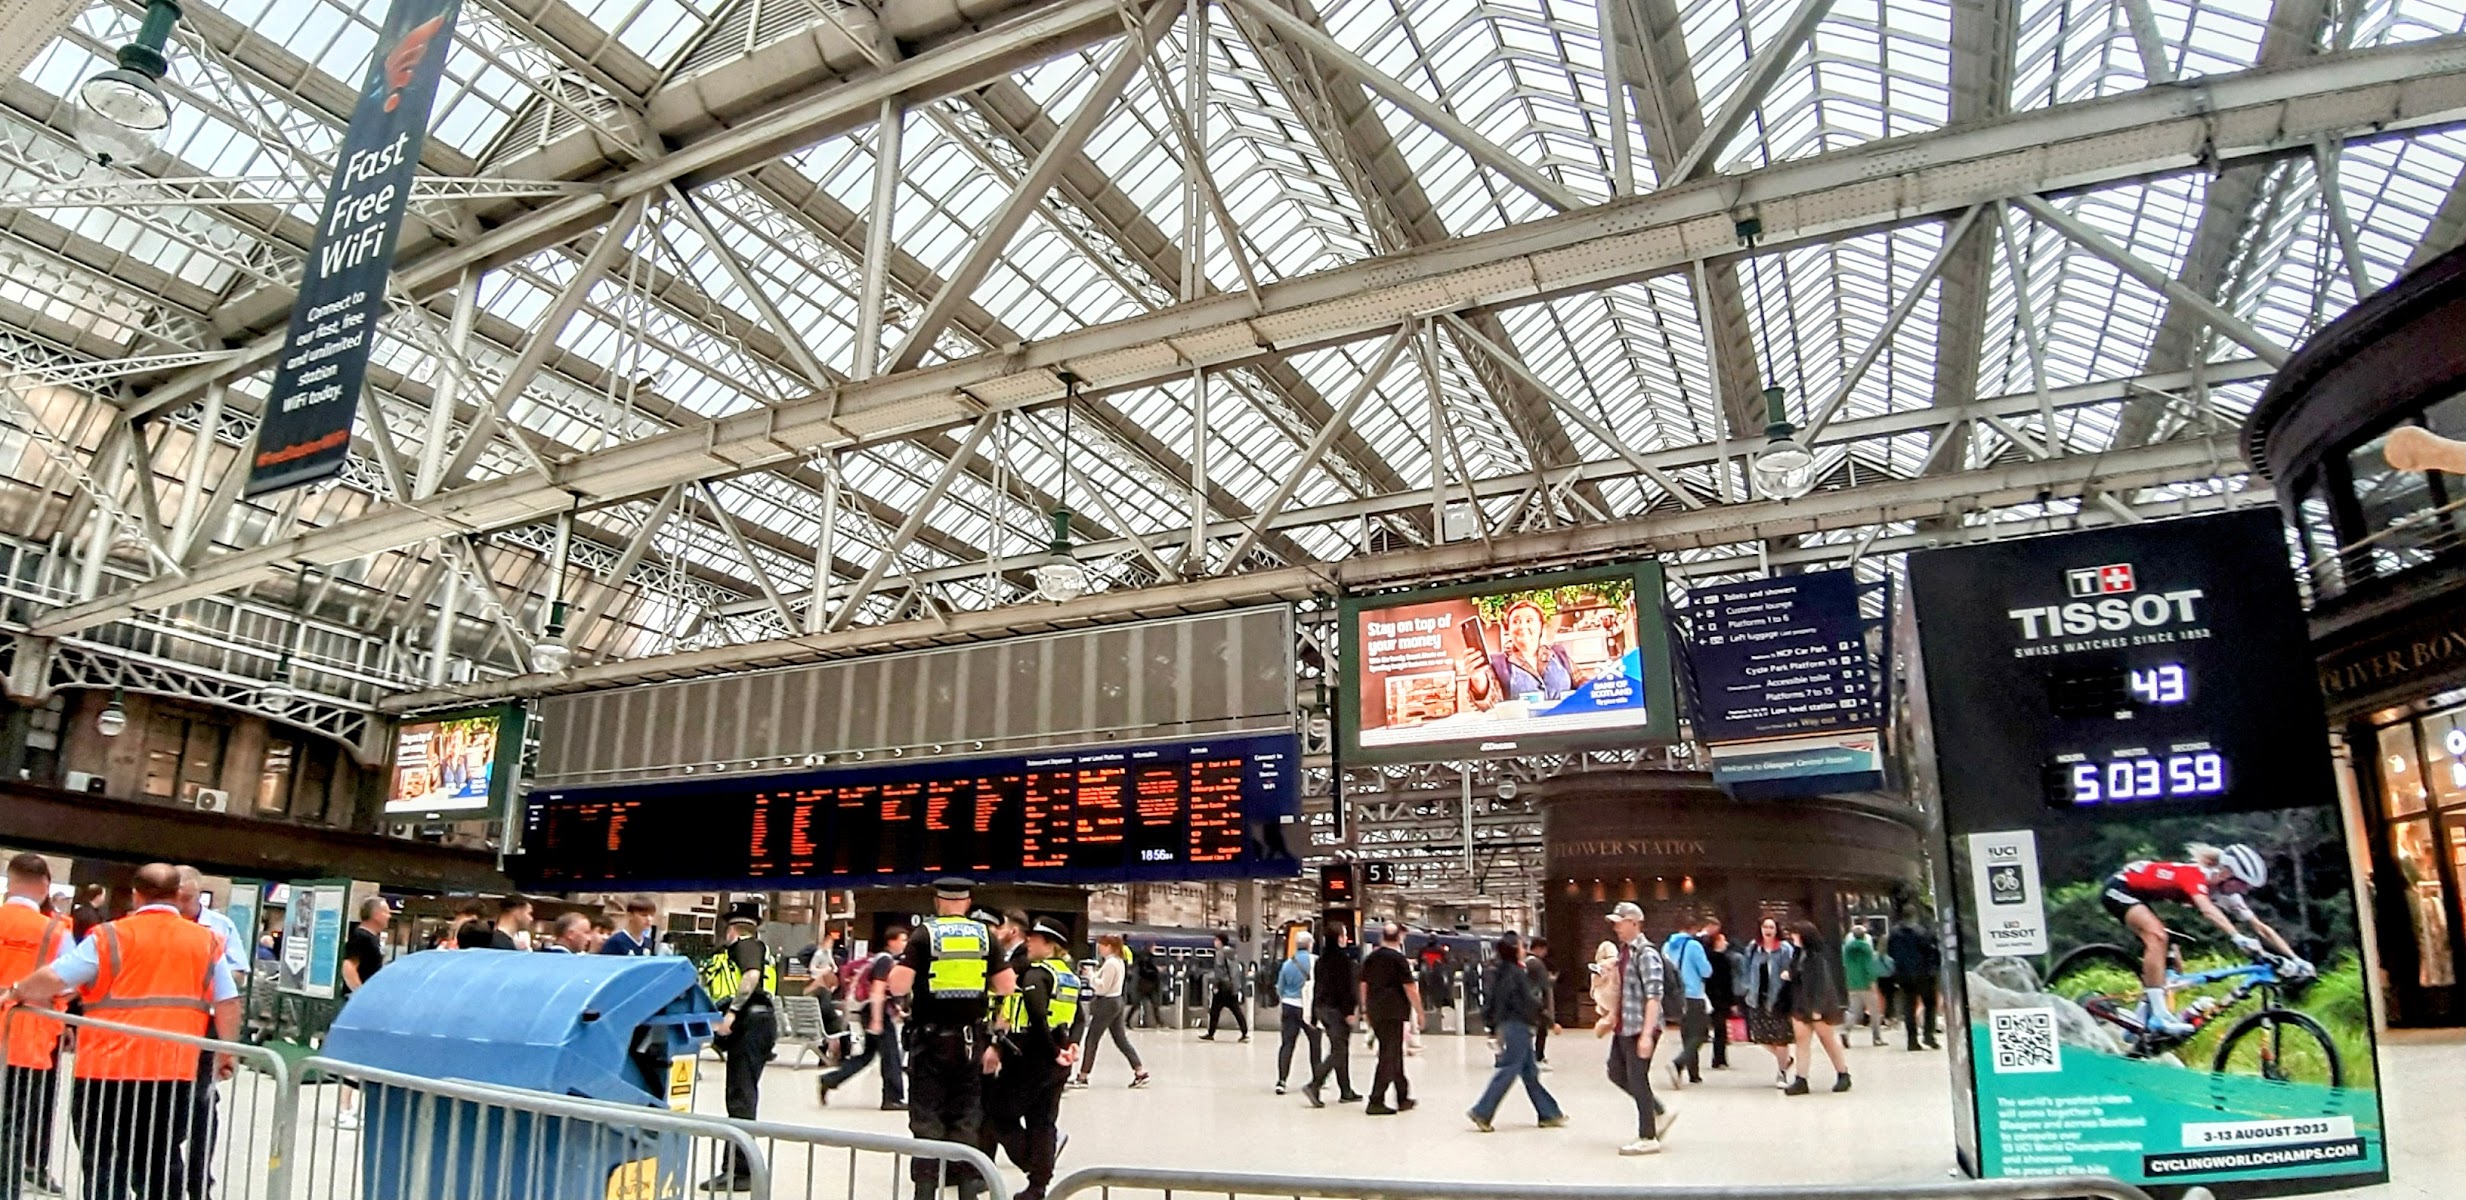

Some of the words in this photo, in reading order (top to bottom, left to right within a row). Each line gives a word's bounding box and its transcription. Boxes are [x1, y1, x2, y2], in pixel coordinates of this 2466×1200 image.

[341, 131, 409, 191] Fast
[327, 184, 395, 237] Free
[320, 221, 387, 279] WiFi
[307, 296, 352, 322] Connect
[352, 291, 366, 305] to
[296, 330, 315, 346] our
[341, 312, 365, 329] free
[286, 350, 309, 370] and
[309, 330, 363, 362] unlimited
[297, 364, 338, 387] station
[1723, 593, 1748, 602] Toilets
[1749, 590, 1763, 598] and
[1764, 587, 1797, 596] showers
[1725, 605, 1763, 615] Customer
[1765, 601, 1793, 610] lounge
[2008, 589, 2204, 640] TISSOT
[1368, 622, 1396, 638] Stay
[1397, 620, 1414, 633] on
[1414, 618, 1436, 634] top
[1437, 612, 1452, 629] of
[1728, 618, 1766, 629] Platforms
[1729, 633, 1746, 643] Left
[1746, 631, 1779, 641] luggage
[2014, 644, 2059, 658] SWISS
[2063, 637, 2128, 653] WATCHES
[2133, 631, 2175, 646] SINCE
[2180, 628, 2211, 640] 1853
[1368, 639, 1397, 657] your
[1398, 633, 1442, 650] money
[1776, 648, 1793, 658] NCP
[1794, 647, 1809, 656] Car
[1810, 645, 1828, 654] Park
[1745, 667, 1769, 676] Cycle
[1770, 664, 1789, 672] Park
[1789, 660, 1827, 670] Platform
[1766, 677, 1808, 687] Accessible
[2131, 664, 2185, 702] 43
[1591, 687, 1633, 698] SCOTLAND
[1765, 691, 1805, 700] Platforms
[1823, 687, 1834, 695] 15
[1770, 707, 1788, 715] Low
[1788, 705, 1808, 713] level
[1808, 703, 1837, 711] station
[1721, 765, 1753, 773] Welcome
[1763, 761, 1795, 770] Glasgow
[1796, 759, 1824, 767] Central
[2073, 764, 2100, 802] 5
[2108, 759, 2162, 798] 03
[2168, 753, 2222, 793] 59
[1627, 840, 1705, 856] STATION
[1369, 865, 1380, 881] 5
[1990, 929, 2036, 939] TISSOT
[1997, 1097, 2016, 1107] The
[2055, 1096, 2099, 1109] greatest
[2099, 1095, 2132, 1105] riders
[1998, 1108, 2016, 1118] will
[2017, 1109, 2046, 1118] come
[2046, 1107, 2092, 1120] together
[2000, 1120, 2042, 1131] Glasgow
[2044, 1120, 2062, 1129] and
[2063, 1120, 2098, 1129] across
[2098, 1117, 2147, 1128] Scotland
[2014, 1132, 2058, 1143] compete
[2059, 1132, 2082, 1141] over
[2204, 1131, 2232, 1142] 3-13
[2235, 1126, 2292, 1140] AUGUST
[2014, 1142, 2034, 1152] UCI
[2034, 1142, 2064, 1152] World
[2064, 1141, 2143, 1153] Championships
[2002, 1155, 2022, 1164] and
[2023, 1154, 2073, 1164] showcase
[2151, 1143, 2359, 1173] CYCLINGWORLDCHAMPS.COM
[2004, 1166, 2021, 1176] the
[2022, 1166, 2055, 1178] power
[2055, 1165, 2066, 1175] of
[2066, 1165, 2086, 1174] the
[2086, 1164, 2110, 1174] bike
